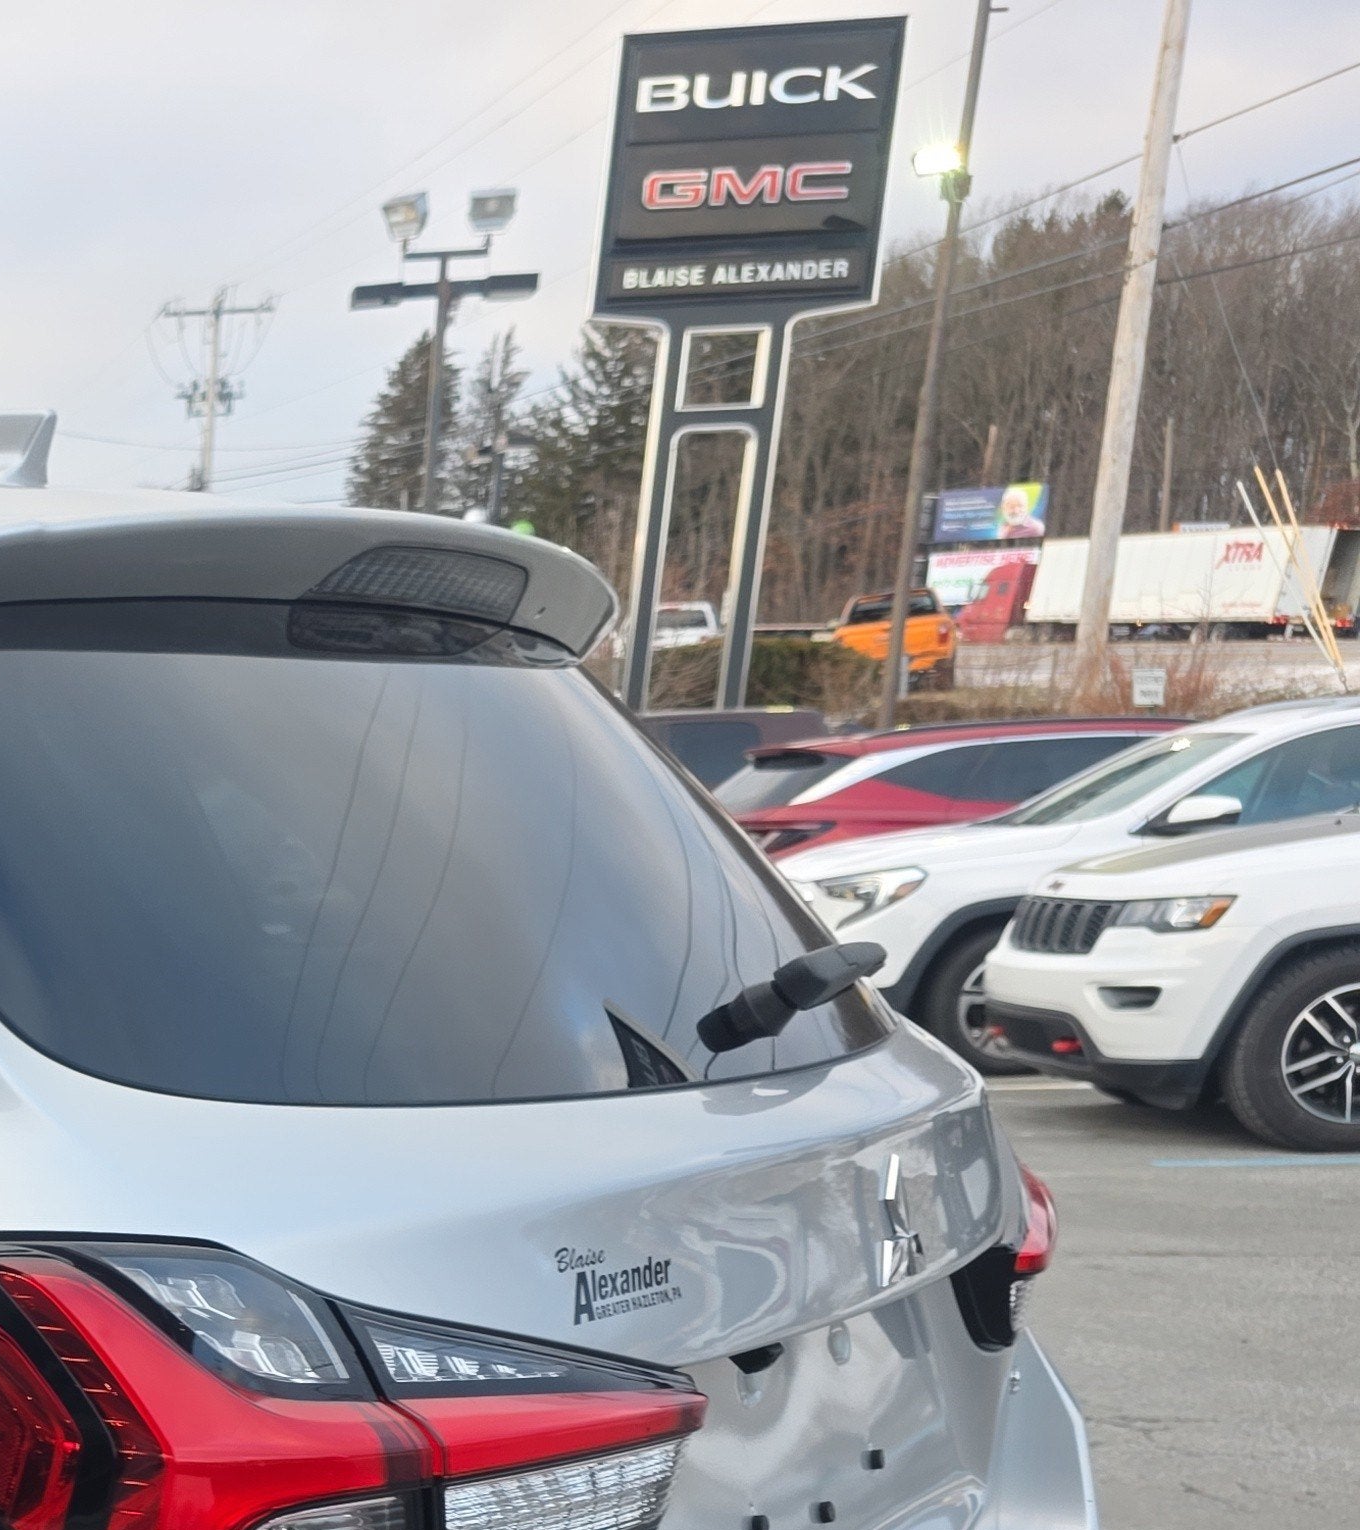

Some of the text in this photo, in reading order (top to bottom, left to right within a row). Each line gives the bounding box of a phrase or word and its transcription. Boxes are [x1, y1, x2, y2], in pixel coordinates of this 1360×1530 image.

[635, 63, 879, 113] BUICK
[642, 162, 852, 210] GMC
[622, 258, 849, 290] BLAISE ALEXANDER
[1216, 542, 1264, 569] XTRA
[554, 1246, 606, 1273] Blaise
[574, 1256, 671, 1325] Alexander
[595, 1299, 632, 1320] GREATER
